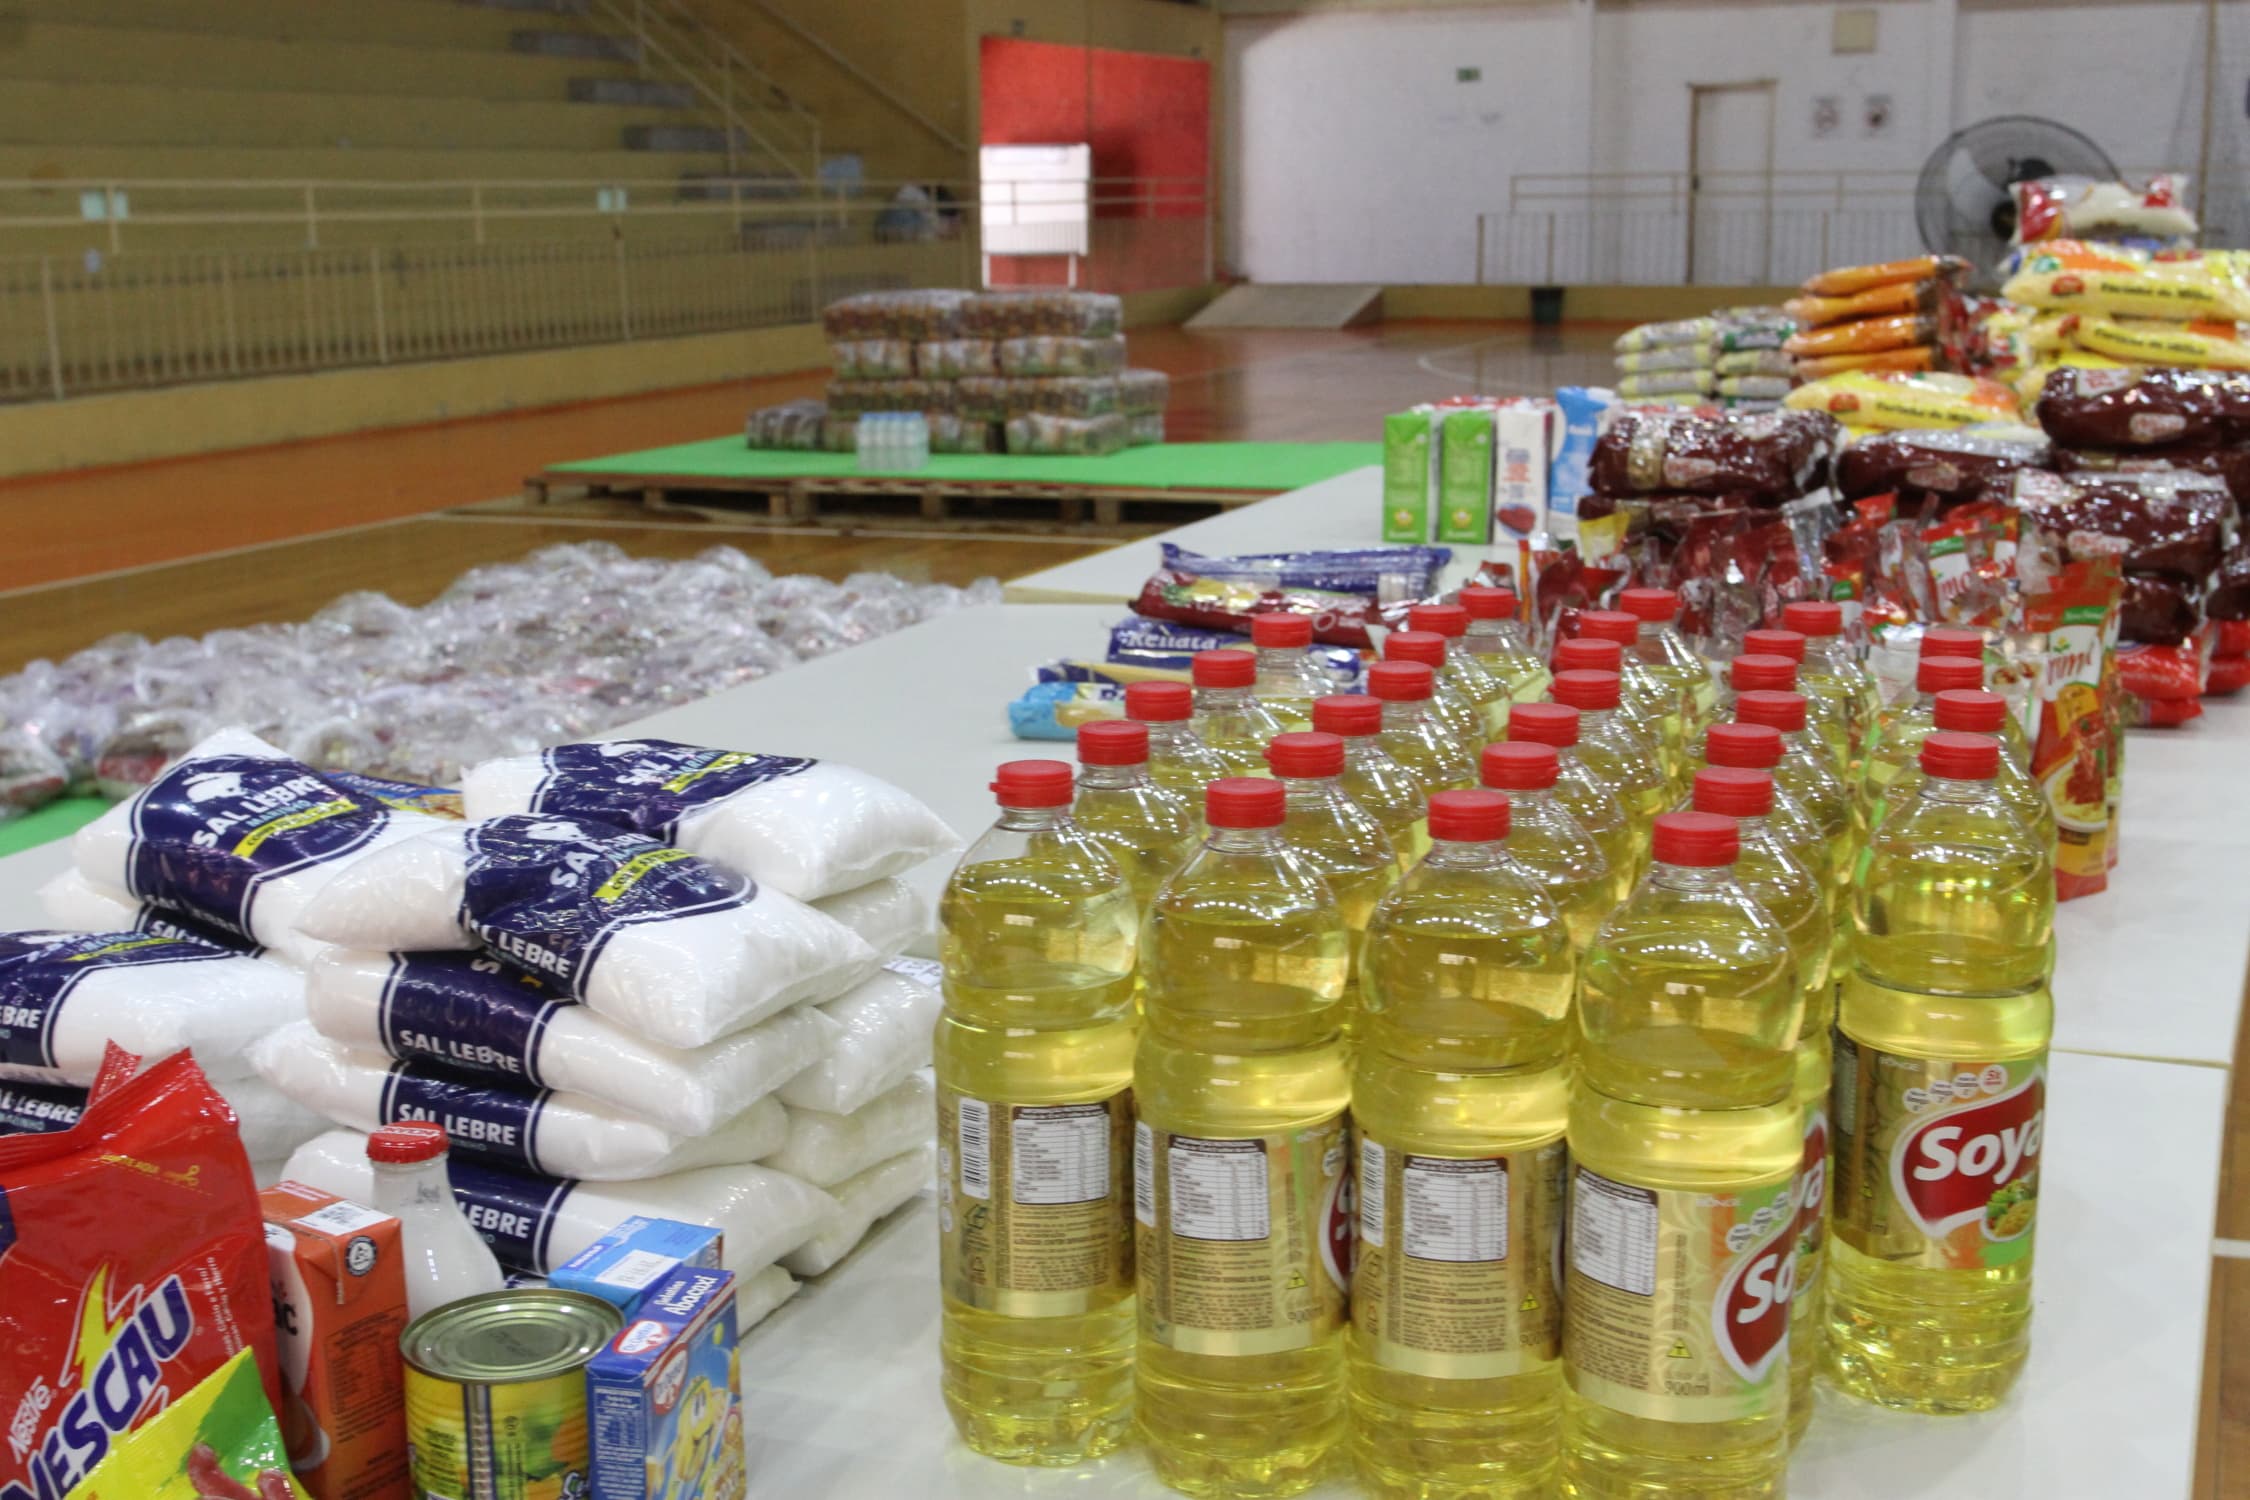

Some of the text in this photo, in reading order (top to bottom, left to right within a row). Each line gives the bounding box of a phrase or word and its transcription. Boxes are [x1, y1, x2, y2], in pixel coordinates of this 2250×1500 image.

[192, 774, 330, 849] SAL LEBRE
[498, 931, 571, 979] LEBRE
[400, 1029, 446, 1055] SAL
[448, 1040, 521, 1074] LEBRE
[13, 1095, 80, 1124] LEBRE
[445, 1114, 516, 1147] LEBRE
[1912, 1109, 2044, 1186] Soya
[662, 1275, 719, 1316] Abacaxi
[8, 1375, 50, 1465] Nestlé
